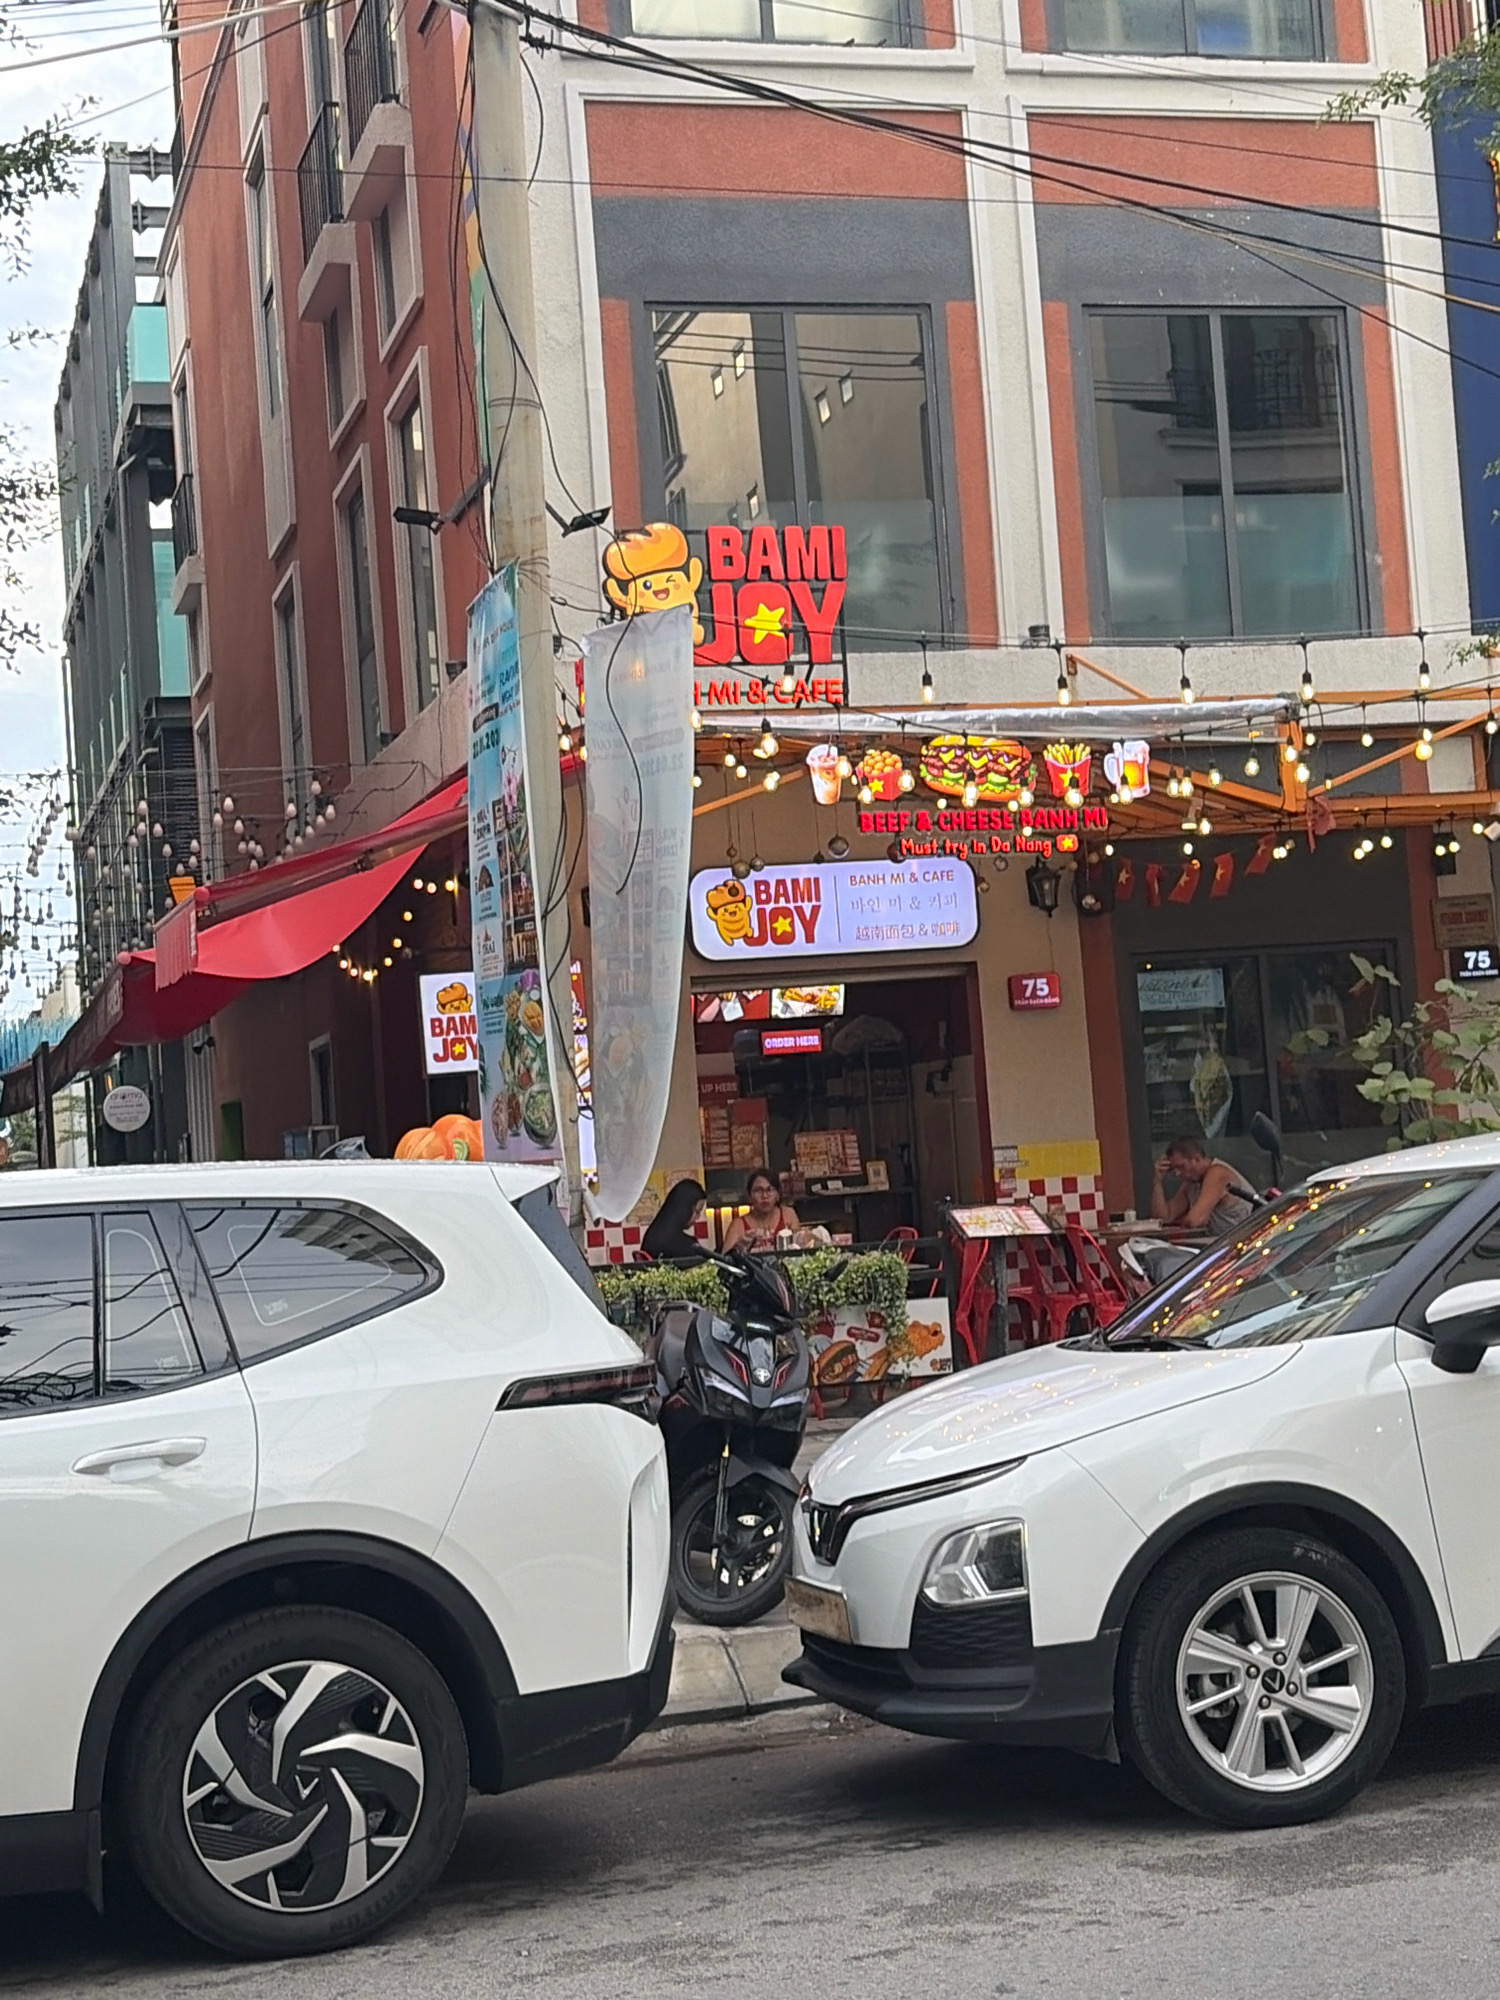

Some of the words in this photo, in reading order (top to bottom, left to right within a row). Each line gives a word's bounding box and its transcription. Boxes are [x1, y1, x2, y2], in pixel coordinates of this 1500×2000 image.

[707, 525, 847, 581] BAMI
[693, 581, 847, 664] JOY
[708, 679, 741, 705] MI
[747, 678, 768, 704] &
[774, 678, 844, 704] CAFE
[860, 811, 910, 833] BEEF
[916, 810, 932, 831] &
[938, 809, 1014, 831] CHEESE
[1020, 808, 1078, 830] BANH
[1083, 806, 1108, 828] MI
[901, 838, 938, 855] Must
[944, 835, 968, 860] try
[990, 836, 1011, 852] Da
[1015, 835, 1052, 858] Nang
[850, 873, 886, 886] BANH
[890, 873, 905, 884] MI
[909, 872, 918, 883] &
[923, 870, 954, 882] CAFE
[754, 877, 821, 905] BAMI
[851, 896, 881, 913] 바인
[889, 895, 902, 912] 미
[910, 896, 920, 910] &
[743, 905, 822, 946] JOY
[919, 923, 928, 936] &
[931, 921, 960, 937] 咖啡
[1464, 950, 1491, 970] 75
[1022, 978, 1049, 997] 75
[430, 1015, 477, 1038] BAM
[433, 1036, 478, 1062] JOY
[764, 1037, 795, 1049] ORDER
[796, 1035, 819, 1047] HERE
[701, 1083, 713, 1093] UP
[715, 1082, 738, 1092] HERE
